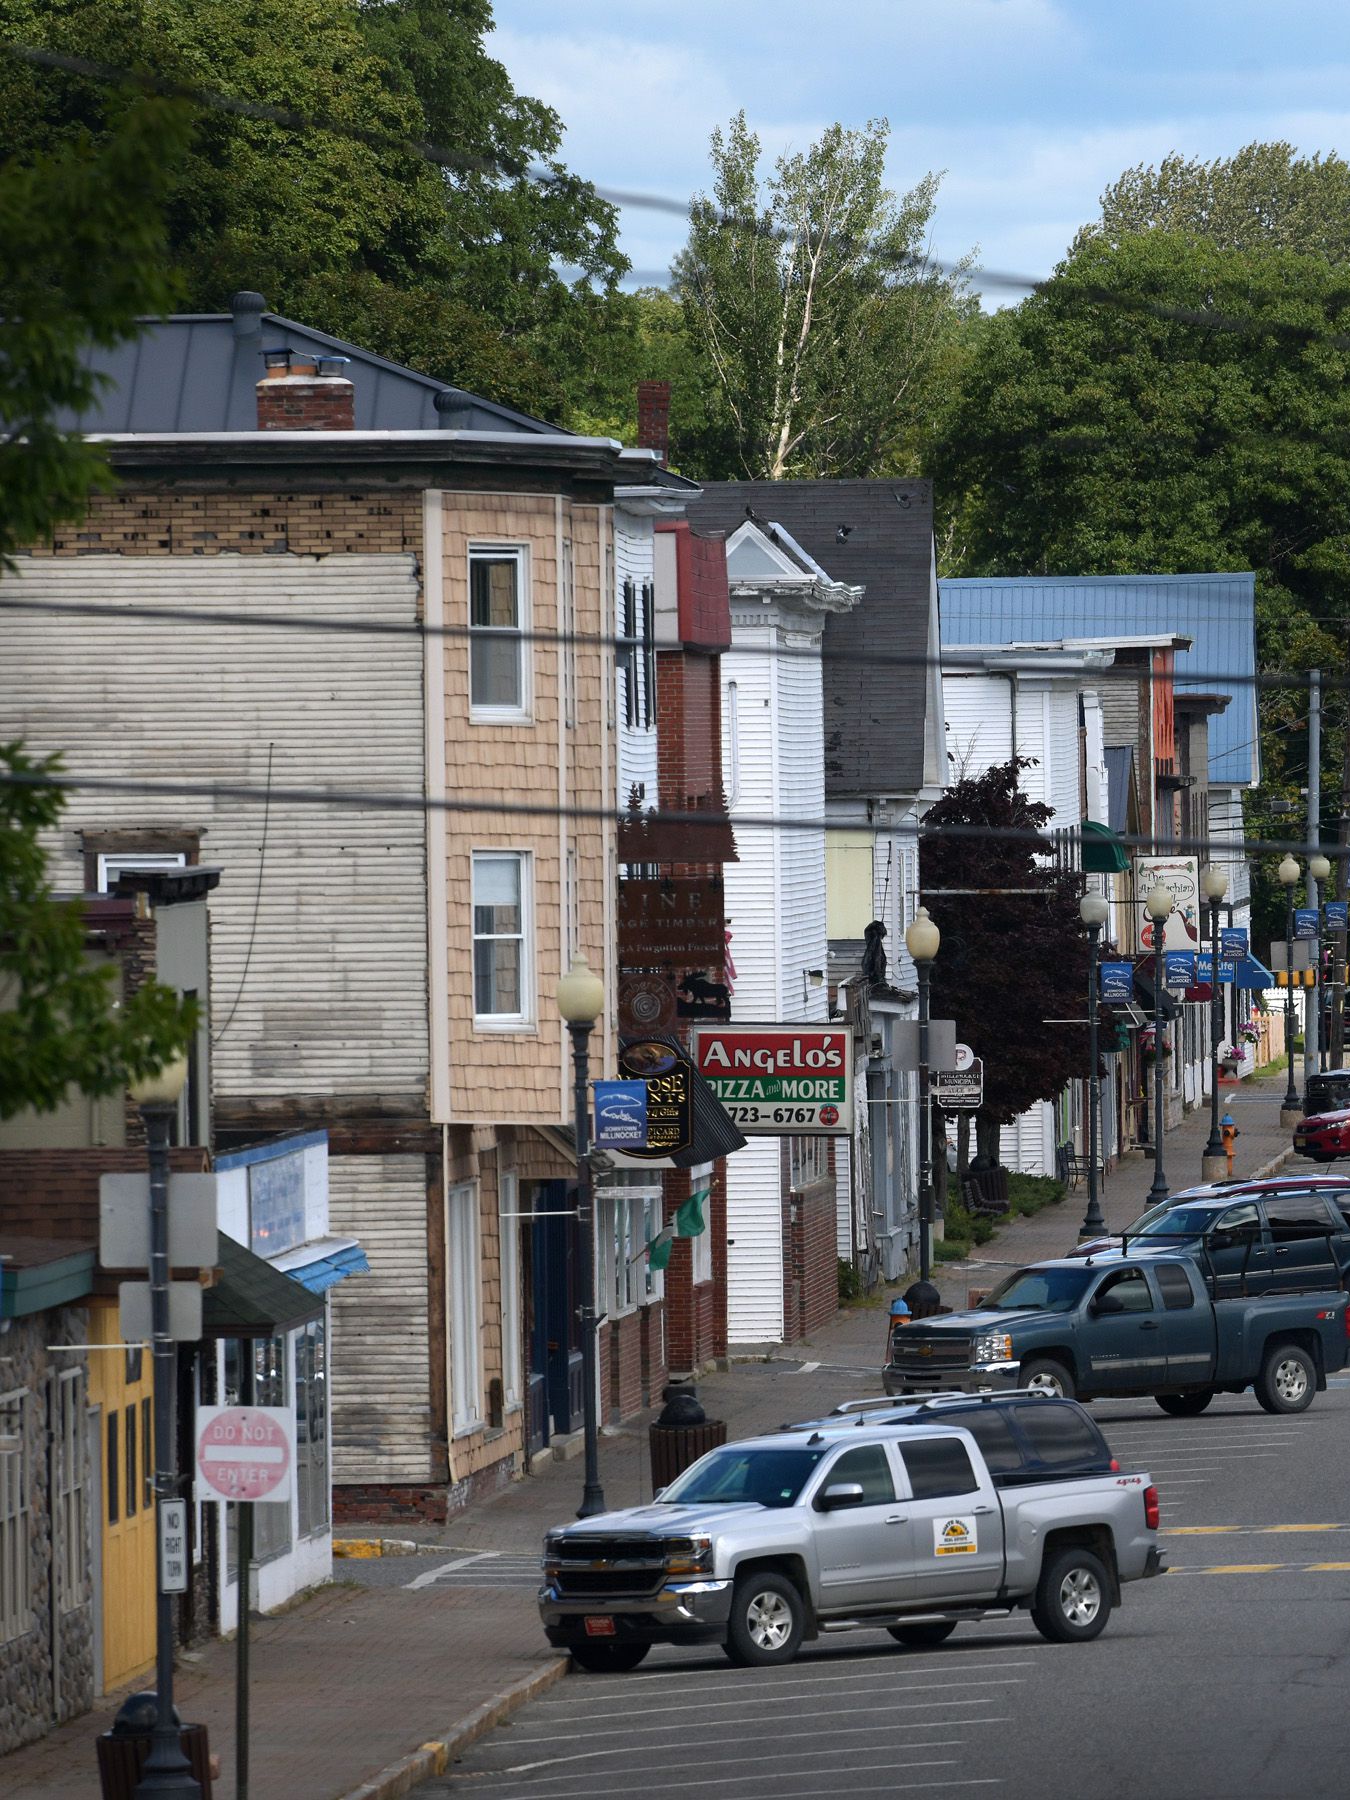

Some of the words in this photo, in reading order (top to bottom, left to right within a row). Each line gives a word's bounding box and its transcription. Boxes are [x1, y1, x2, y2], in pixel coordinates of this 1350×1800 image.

[618, 892, 701, 911] AINE
[1198, 960, 1233, 971] MeLife
[782, 1080, 839, 1098] MORE
[728, 1107, 816, 1123] 723-6767
[600, 1131, 642, 1139] MILLINOCKET
[213, 1426, 235, 1440] DO
[243, 1427, 274, 1441] NOT
[217, 1468, 268, 1482] ENTER
[167, 1514, 180, 1529] NO
[165, 1536, 182, 1554] RIGHT
[167, 1559, 182, 1577] TURN
